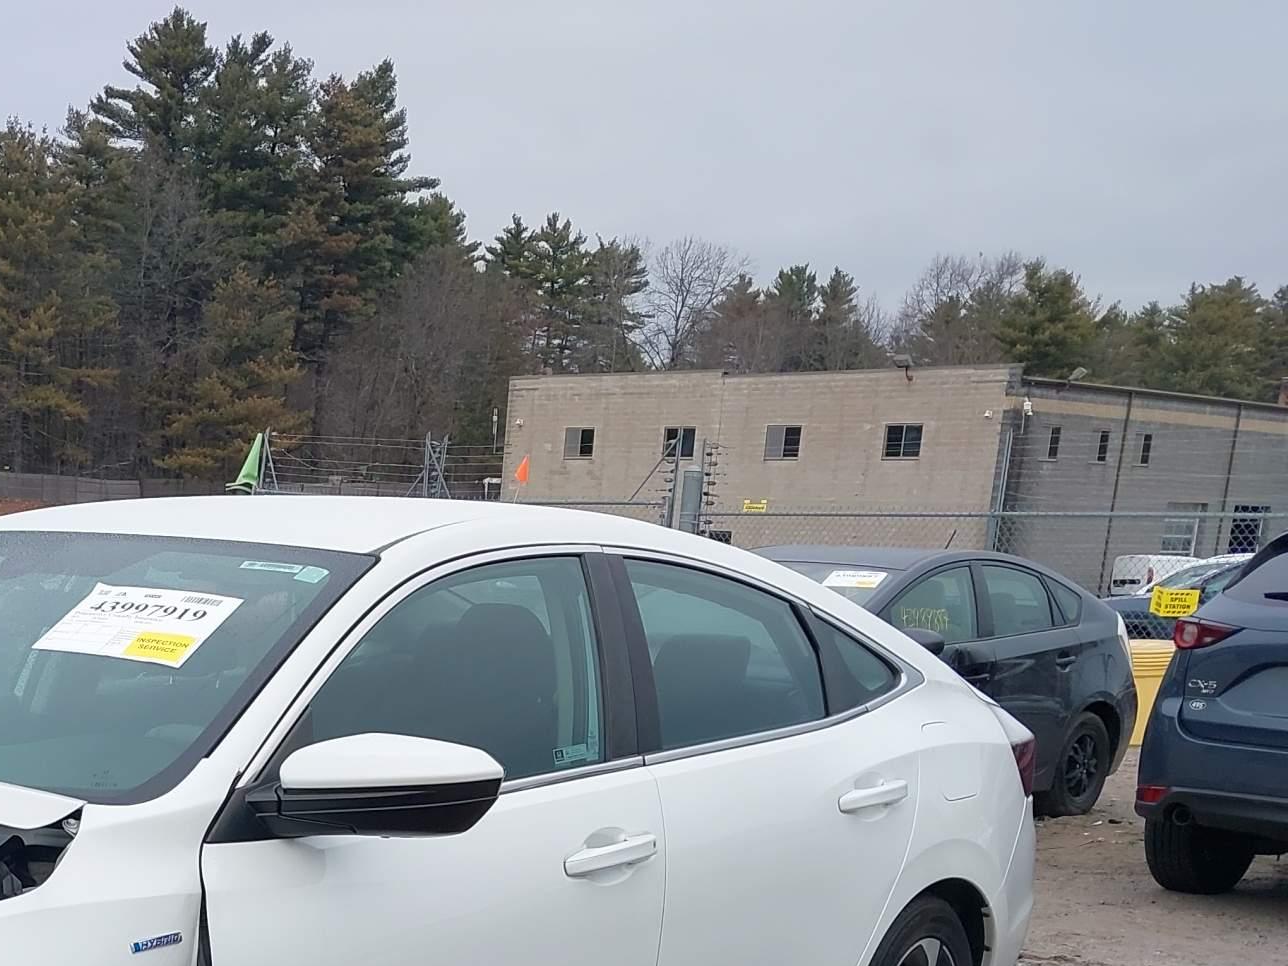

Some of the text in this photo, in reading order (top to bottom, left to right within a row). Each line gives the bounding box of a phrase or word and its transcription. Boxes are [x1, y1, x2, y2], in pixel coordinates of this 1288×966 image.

[90, 600, 208, 622] 43997919
[136, 637, 190, 649] INSPECTION
[137, 643, 177, 653] SERVICE
[1188, 679, 1217, 689] CX-5
[138, 932, 183, 951] HYBRID
